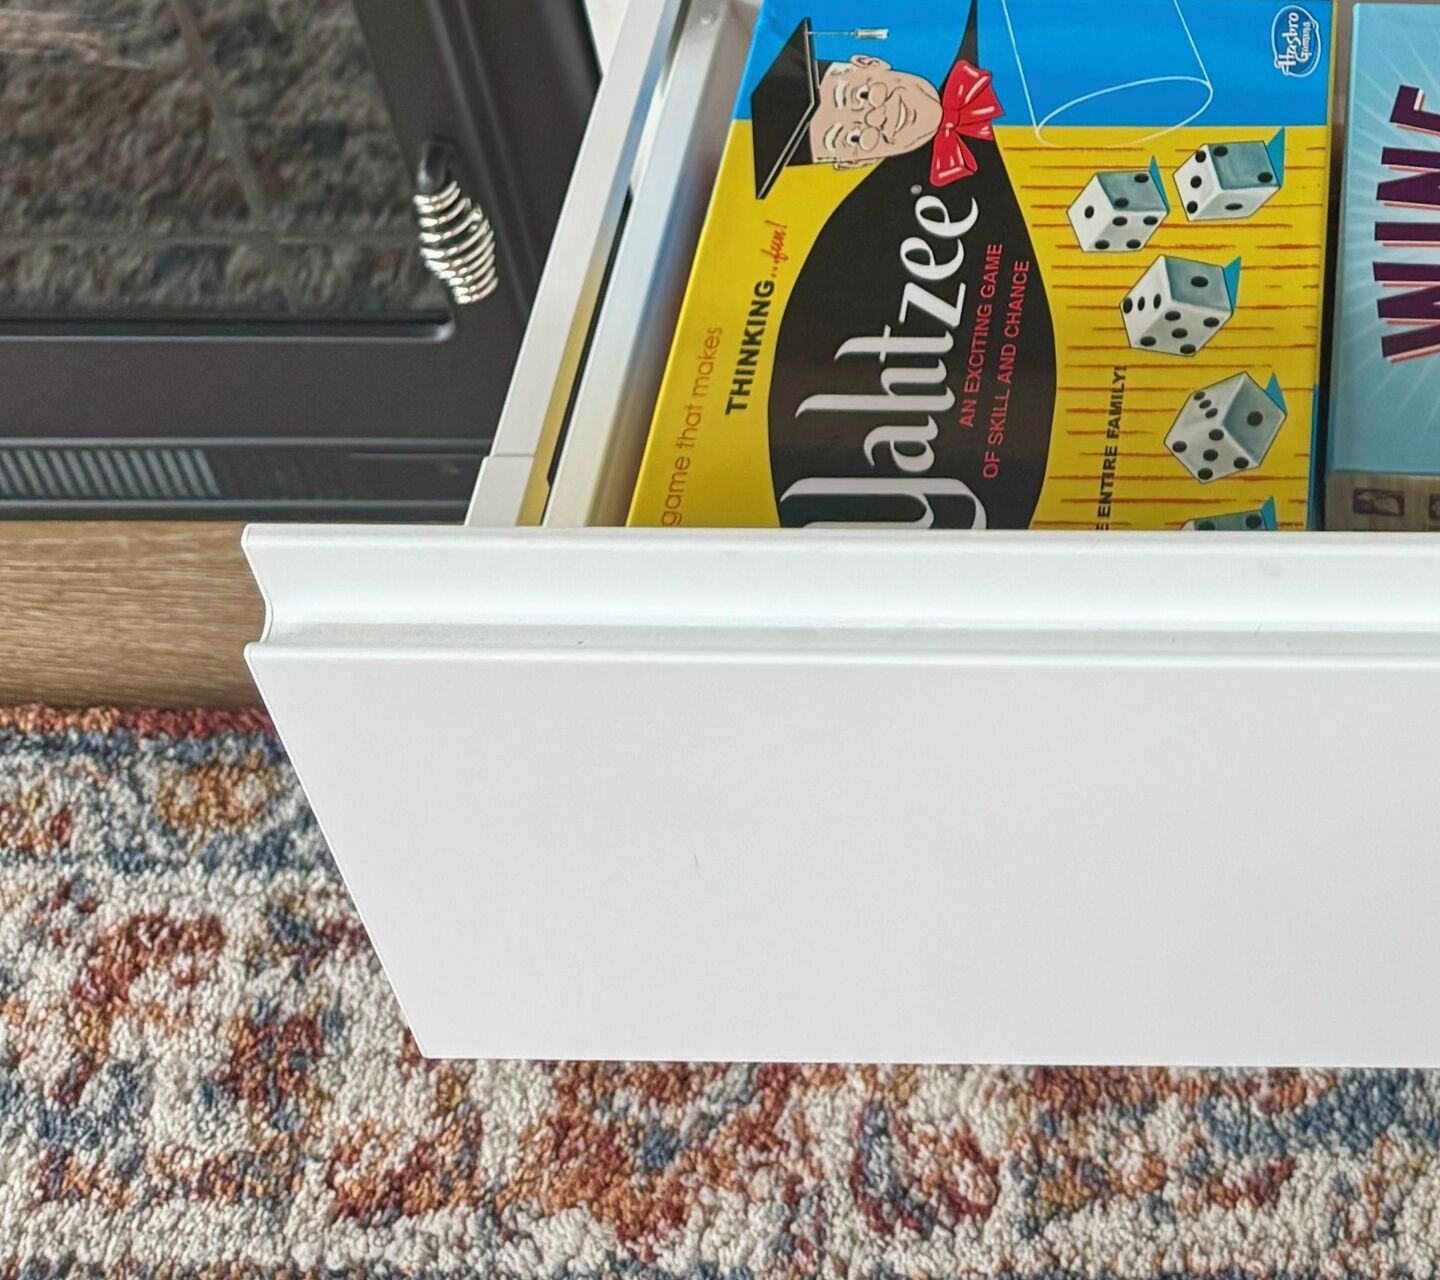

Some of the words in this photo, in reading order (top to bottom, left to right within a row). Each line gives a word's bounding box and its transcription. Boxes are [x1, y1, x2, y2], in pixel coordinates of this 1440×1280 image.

[1278, 12, 1301, 73] Hasbro
[980, 244, 1003, 298] GAME
[1004, 260, 1030, 338] CHANCE
[964, 304, 992, 393] EXCITING
[997, 344, 1017, 384] AND
[661, 456, 691, 527] game
[676, 401, 704, 449] that
[693, 327, 722, 398] makes
[959, 400, 977, 428] AN
[988, 389, 1010, 444] SKILL
[1107, 365, 1127, 439] FAMILY!
[982, 451, 1000, 478] OF
[1097, 445, 1118, 519] ENTIRE
